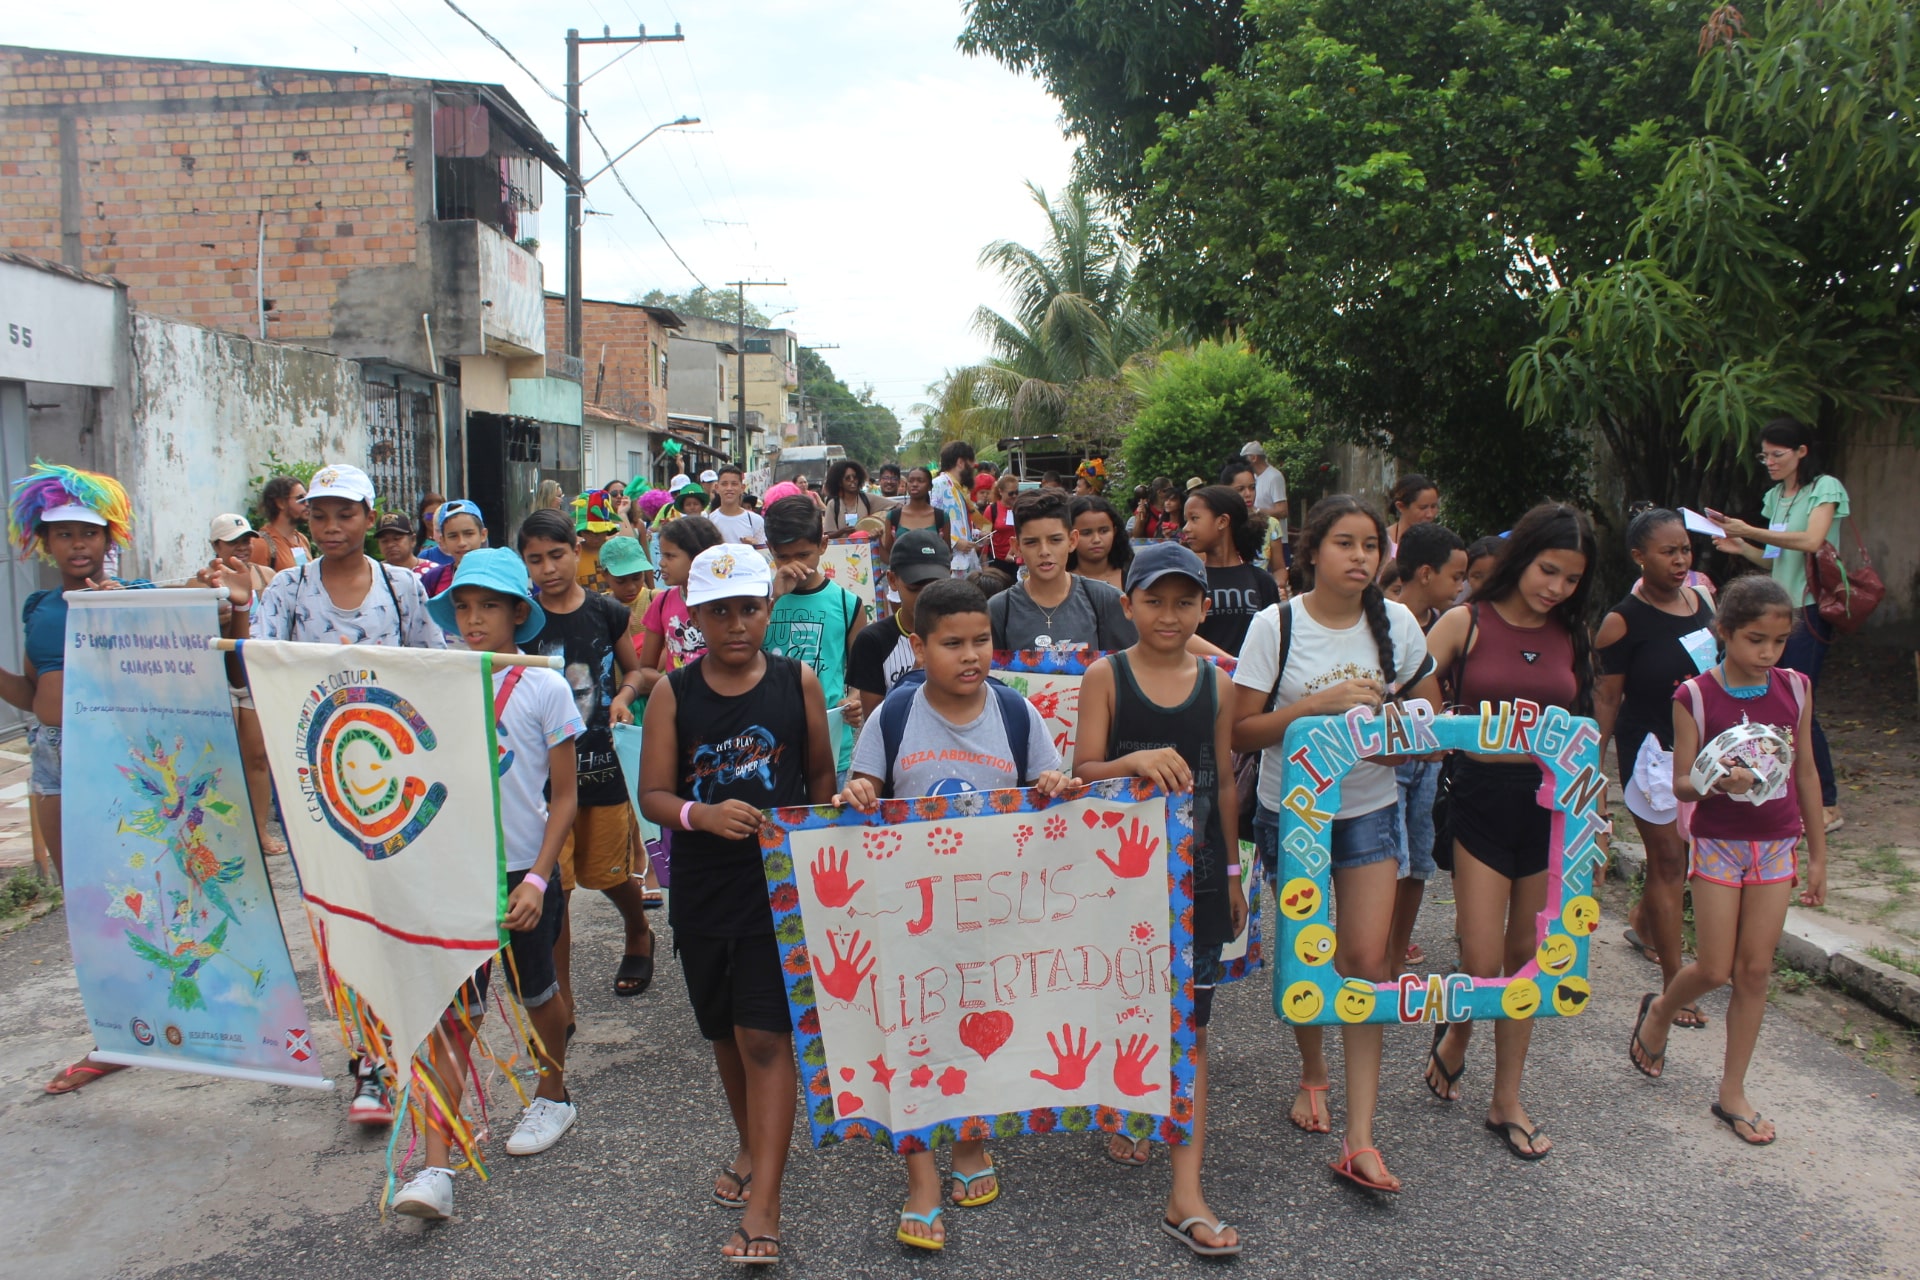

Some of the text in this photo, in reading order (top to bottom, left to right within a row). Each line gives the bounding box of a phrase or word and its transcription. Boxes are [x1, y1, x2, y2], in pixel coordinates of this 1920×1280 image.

[8, 322, 33, 349] 55
[1215, 608, 1245, 616] SPORT
[89, 633, 132, 650] ENCONTRO
[132, 633, 171, 650] BRINCAR
[164, 660, 177, 674] DO
[178, 660, 196, 676] CAC
[295, 669, 379, 823] CENTRO ALTERNATIVO DE CULTURA
[736, 737, 754, 748] PLAY
[735, 760, 759, 776] GAMER
[901, 748, 1016, 774] PIZZA ABDUCTION
[1281, 698, 1610, 895] BRINCAR URGENTE
[905, 864, 1078, 936] JESUS
[1397, 973, 1475, 1024] CAC
